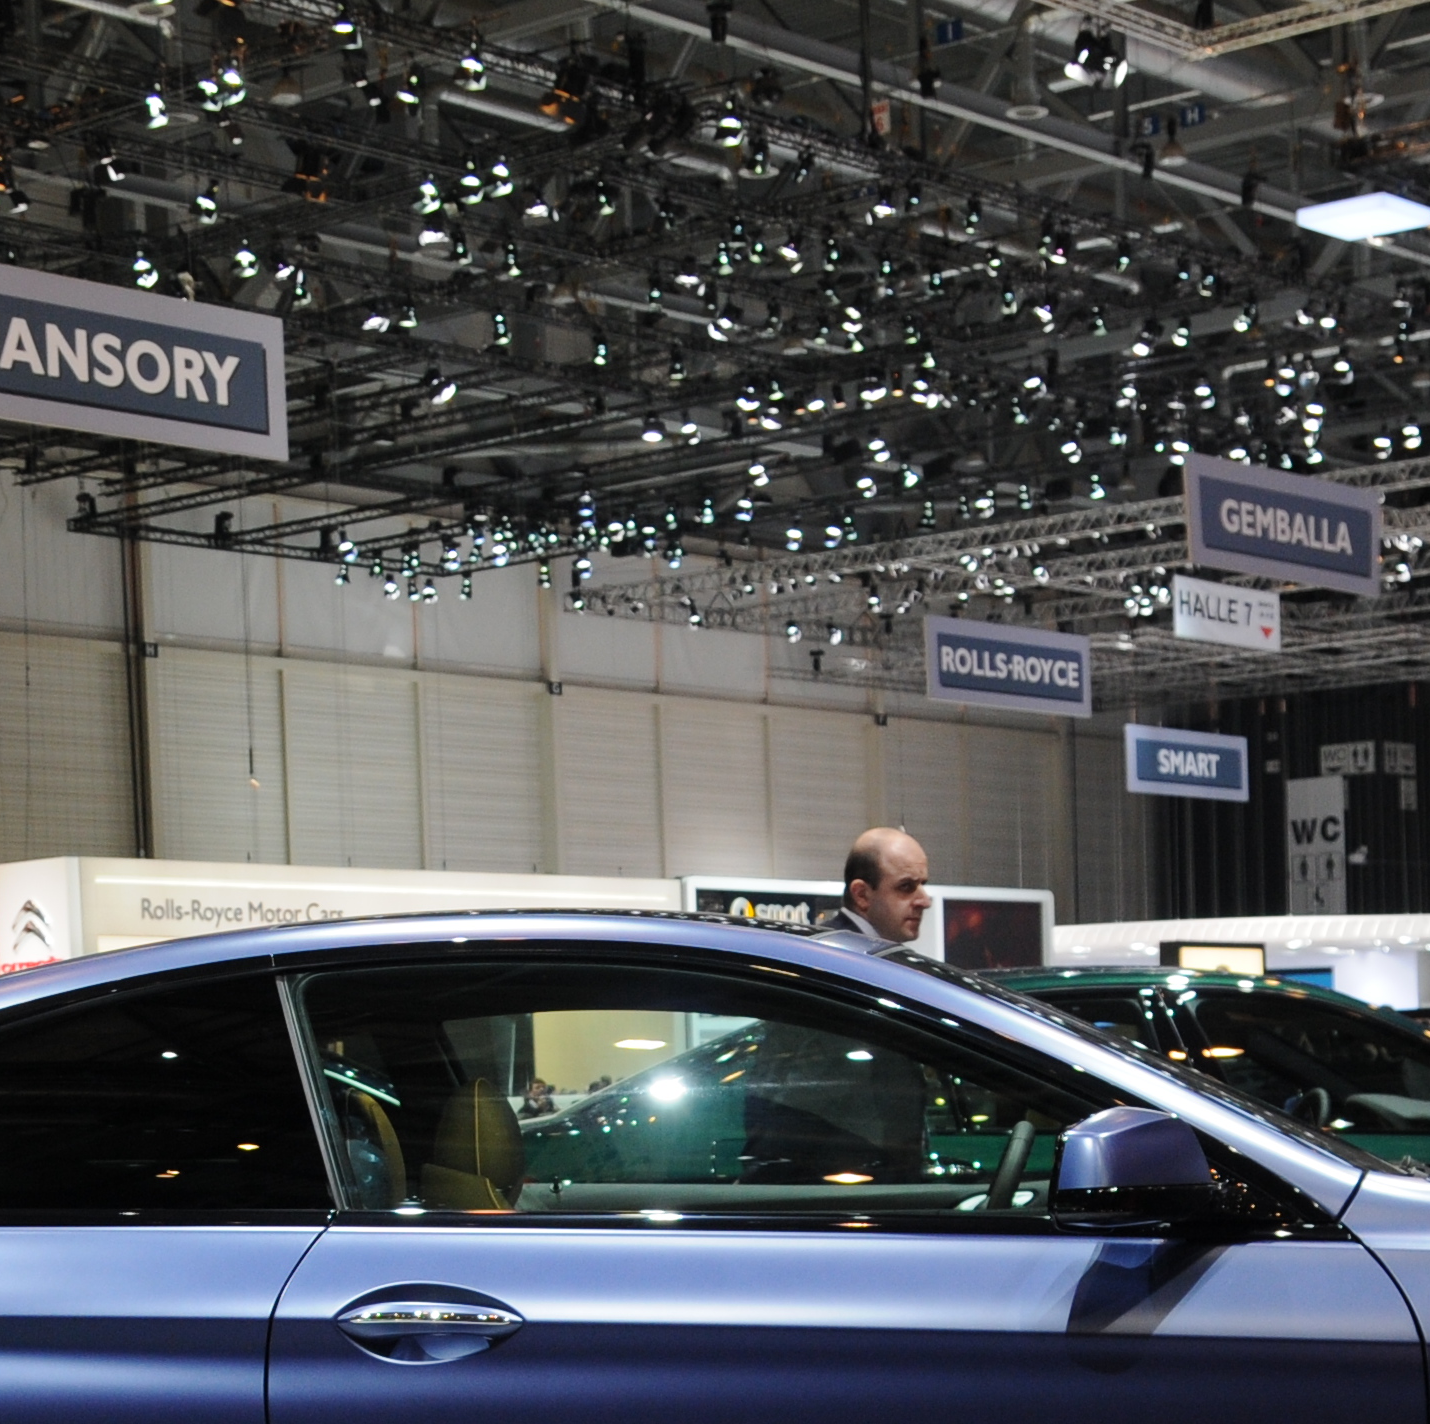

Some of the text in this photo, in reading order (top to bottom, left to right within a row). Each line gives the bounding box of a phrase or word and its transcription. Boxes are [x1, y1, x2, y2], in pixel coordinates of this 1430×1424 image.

[1221, 498, 1353, 555] GEMBALLA
[1178, 589, 1253, 627] HALLE 7
[940, 645, 1081, 688] ROLLS-ROYCE
[1157, 748, 1221, 779] SMART
[1291, 815, 1342, 845] WC
[140, 897, 243, 928] Rolls-Royce
[248, 901, 302, 923] Motor
[754, 901, 810, 925] smart
